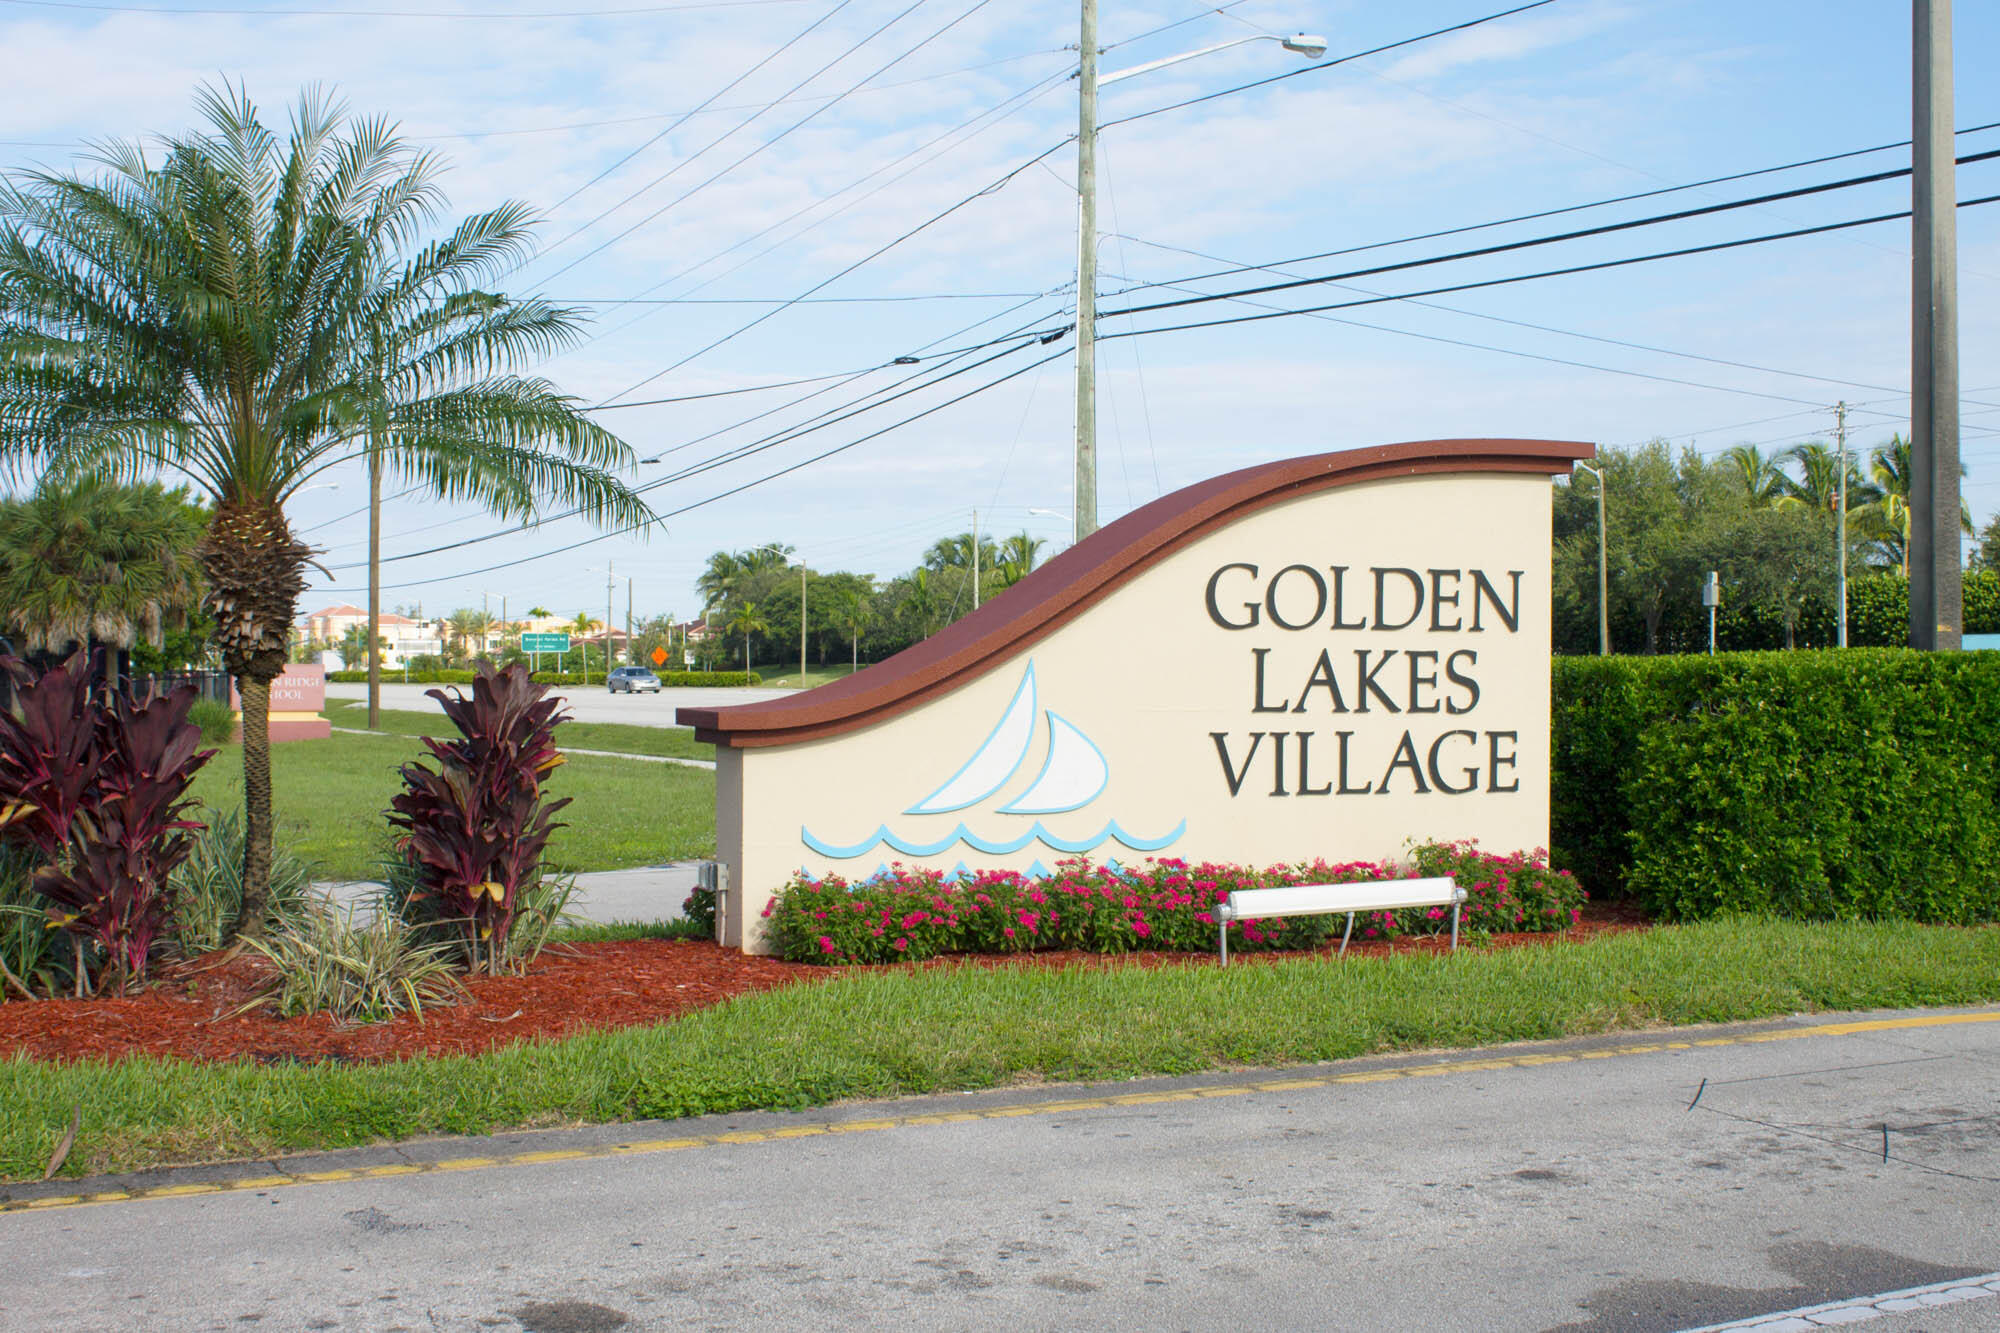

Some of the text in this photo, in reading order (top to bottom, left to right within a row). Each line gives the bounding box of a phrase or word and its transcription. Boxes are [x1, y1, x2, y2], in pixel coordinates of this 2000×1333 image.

[1205, 562, 1525, 633] GOLDEN
[271, 688, 304, 700] HOOL
[1251, 647, 1481, 715] LAKES
[1208, 729, 1520, 797] VILLAGE
